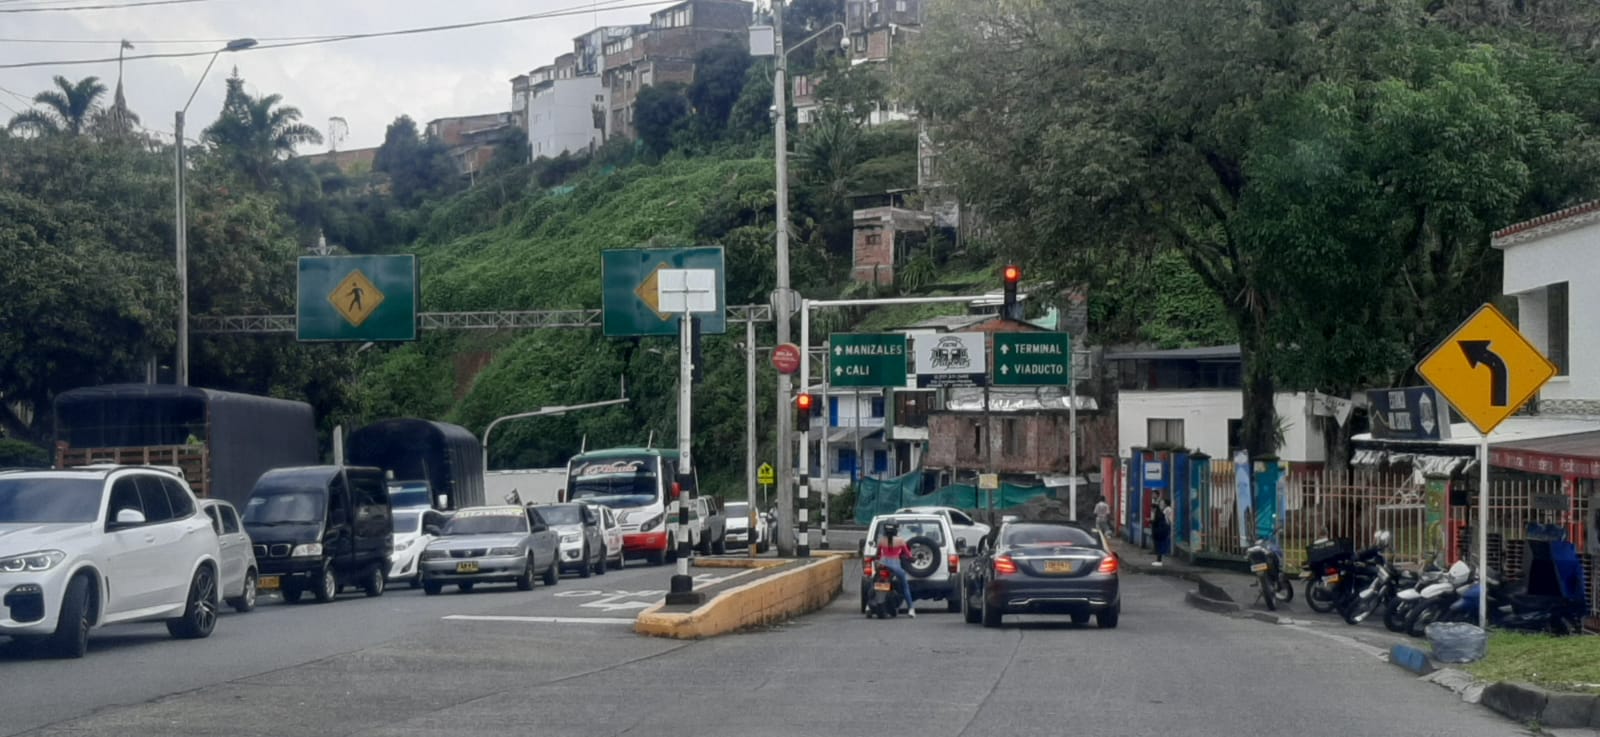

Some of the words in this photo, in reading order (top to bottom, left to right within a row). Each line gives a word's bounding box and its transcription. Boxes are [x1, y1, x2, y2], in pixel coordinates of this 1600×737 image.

[845, 345, 903, 355] MANIZALES
[1014, 344, 1062, 354] TERMINAL
[846, 365, 870, 375] CALI
[1014, 364, 1063, 374] VIADUCTO
